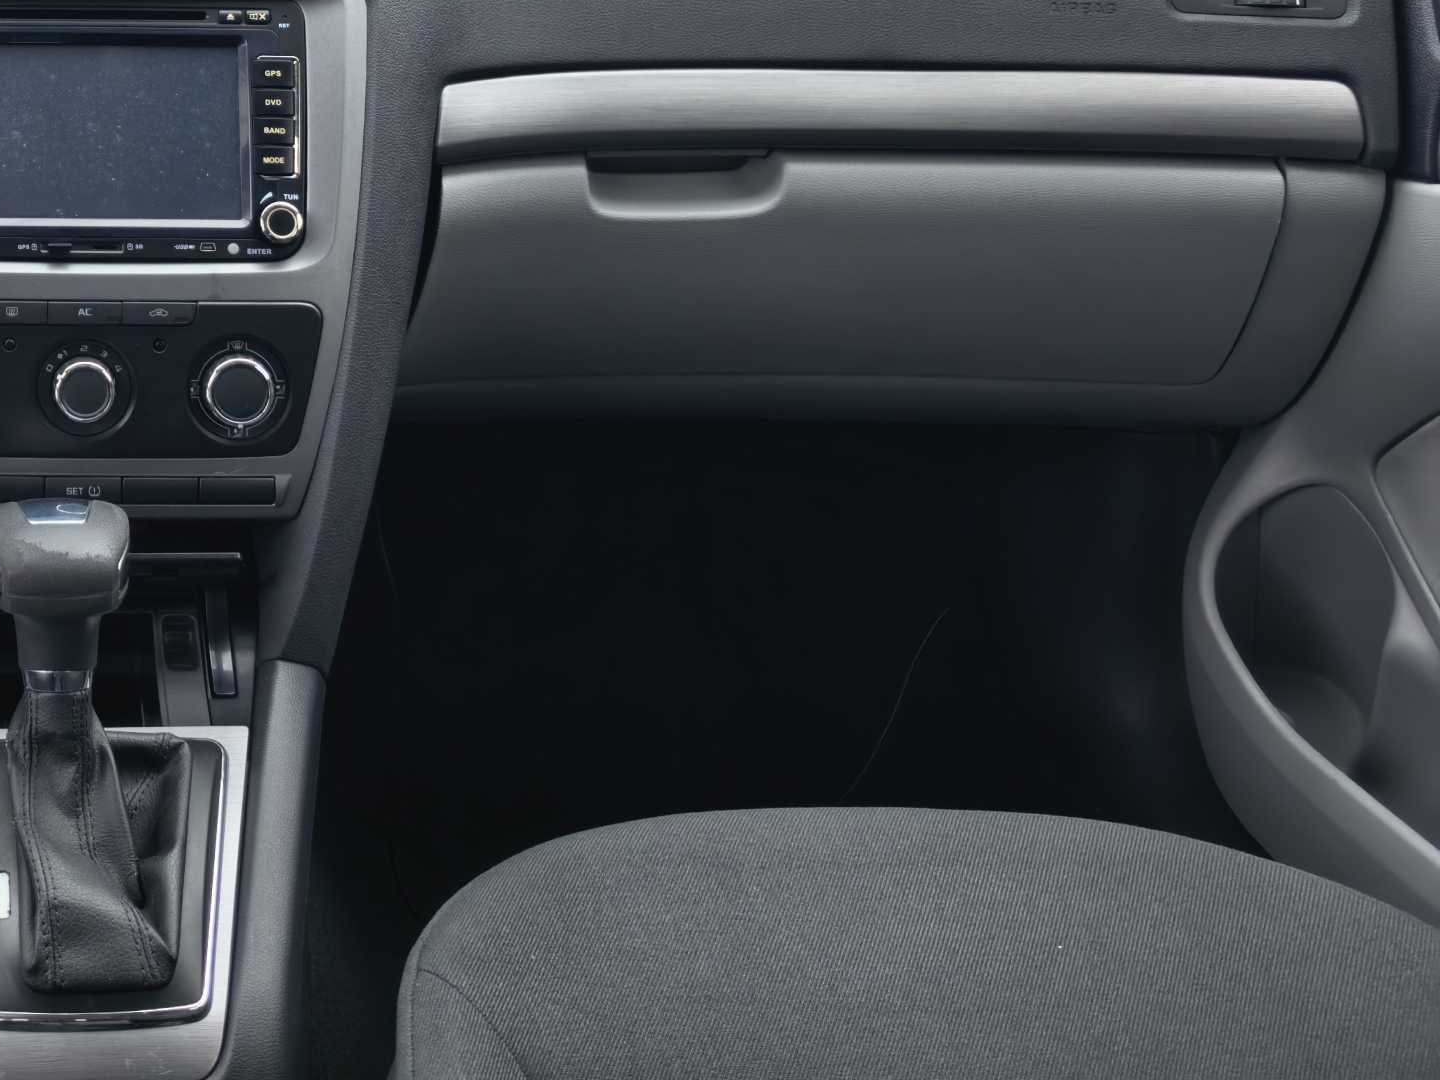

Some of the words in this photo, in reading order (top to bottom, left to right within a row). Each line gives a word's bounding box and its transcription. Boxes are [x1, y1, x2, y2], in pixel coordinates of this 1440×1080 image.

[263, 126, 286, 134] BAND
[262, 156, 285, 164] MODE
[78, 307, 94, 317] AC
[66, 487, 83, 496] SET
